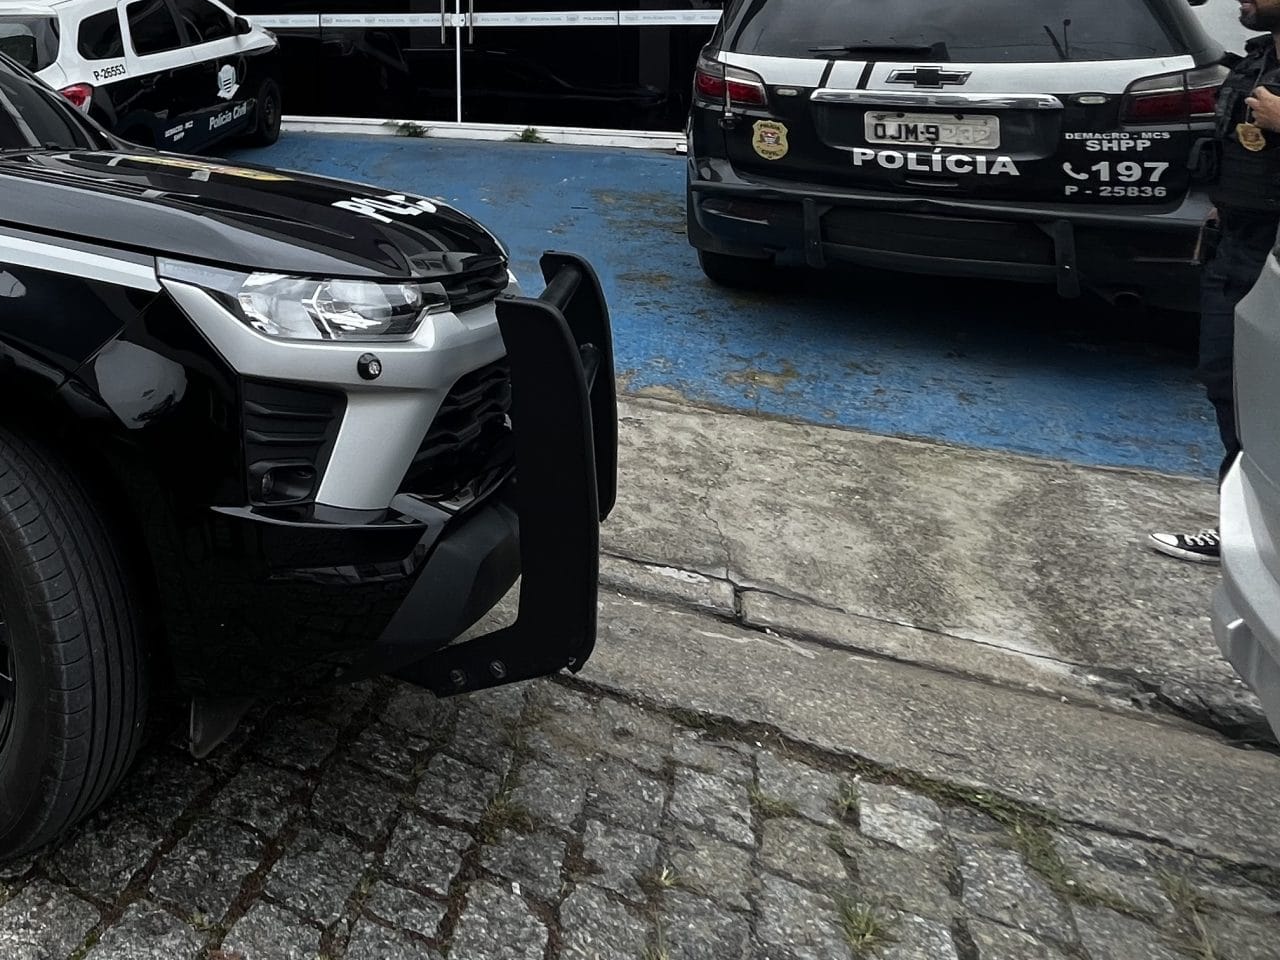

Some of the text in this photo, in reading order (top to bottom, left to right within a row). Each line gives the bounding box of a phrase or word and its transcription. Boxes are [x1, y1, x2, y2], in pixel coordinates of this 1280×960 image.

[1065, 132, 1130, 140] DEMACRO
[1085, 139, 1151, 151] SHPP
[853, 147, 1020, 176] POLÍCIA
[1091, 161, 1170, 182] 197
[1064, 185, 1079, 196] P
[1099, 186, 1167, 197] 25836
